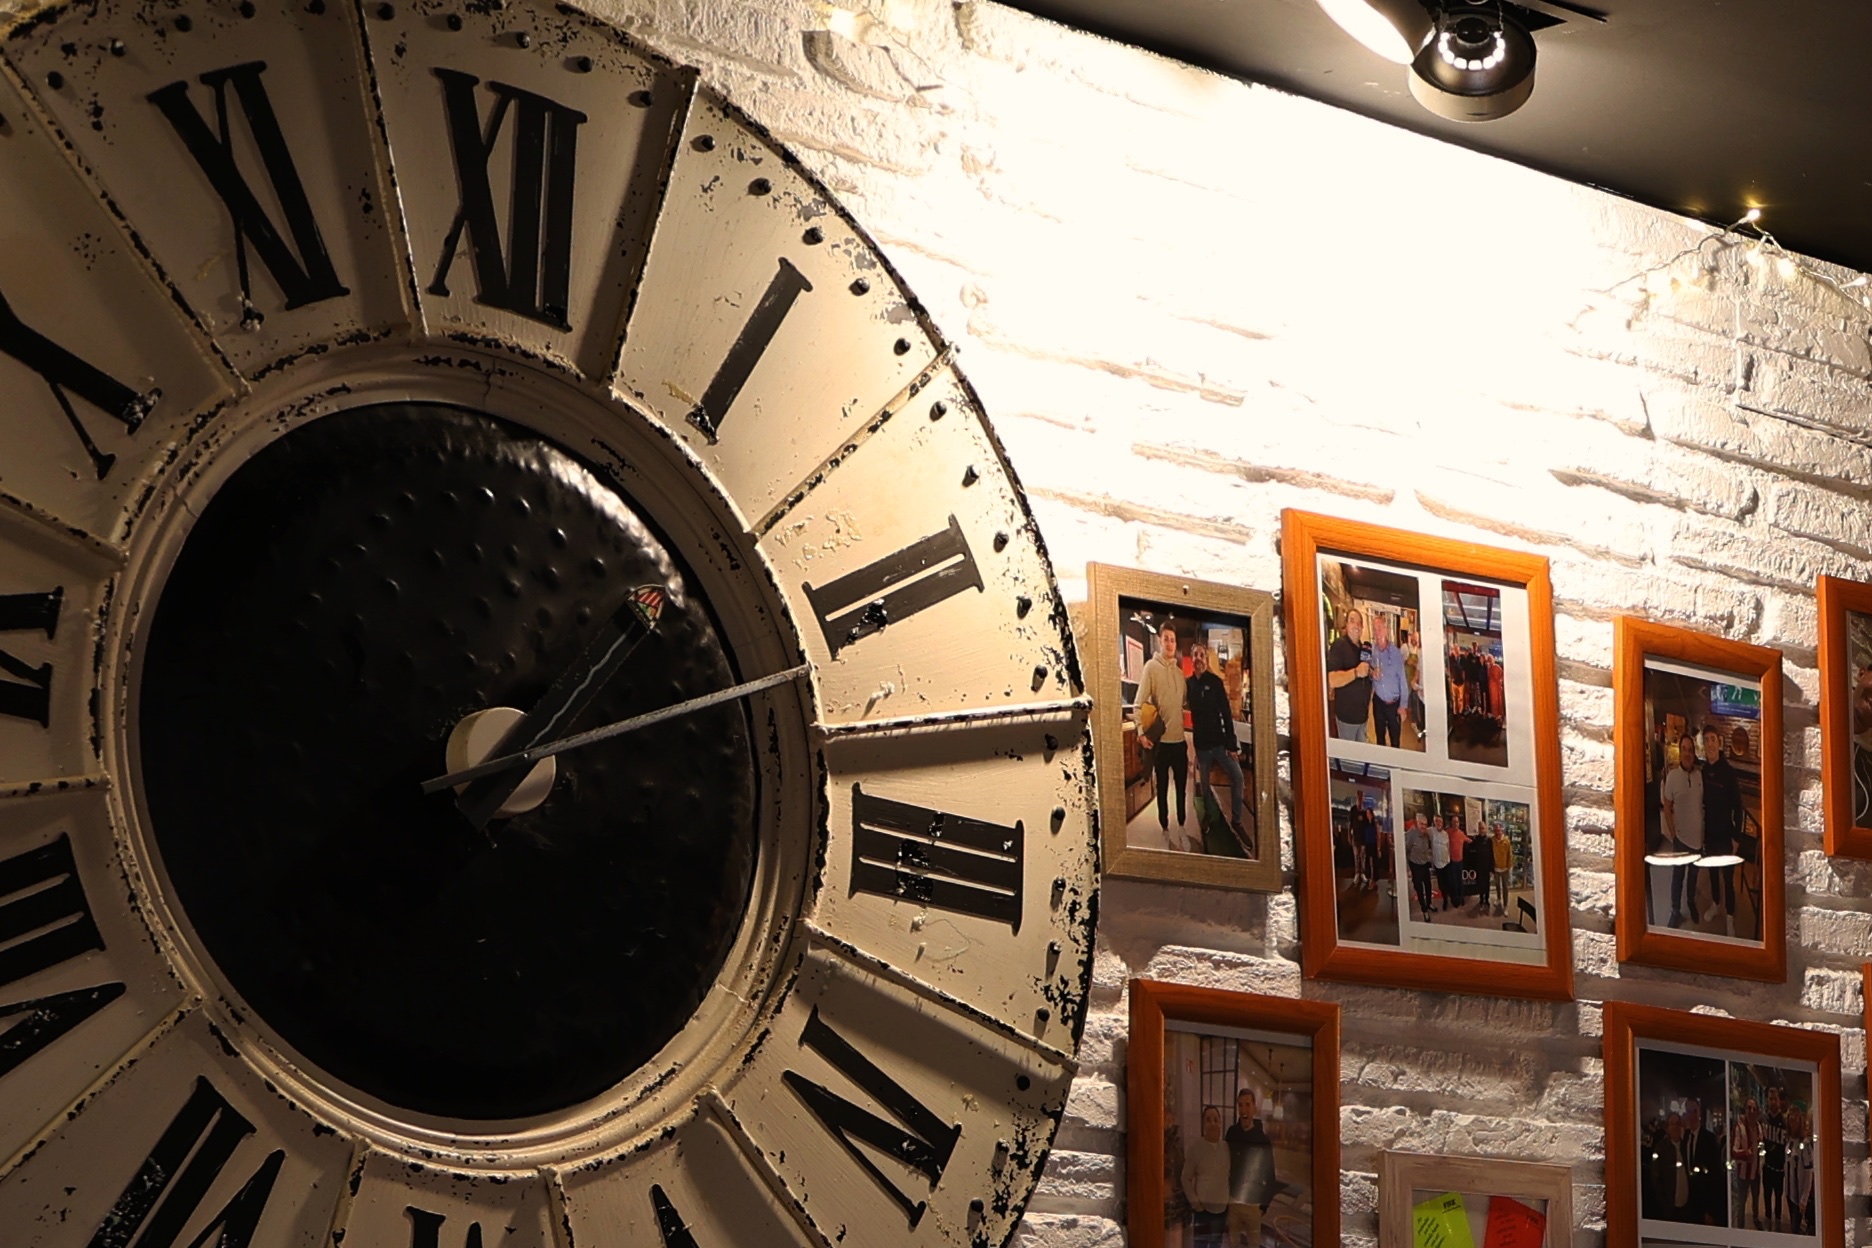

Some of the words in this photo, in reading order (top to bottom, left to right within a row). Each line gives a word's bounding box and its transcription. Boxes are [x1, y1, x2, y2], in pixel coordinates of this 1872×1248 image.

[147, 60, 350, 312] XI
[428, 66, 588, 333] XII
[801, 513, 986, 658] II
[849, 782, 1025, 934] III
